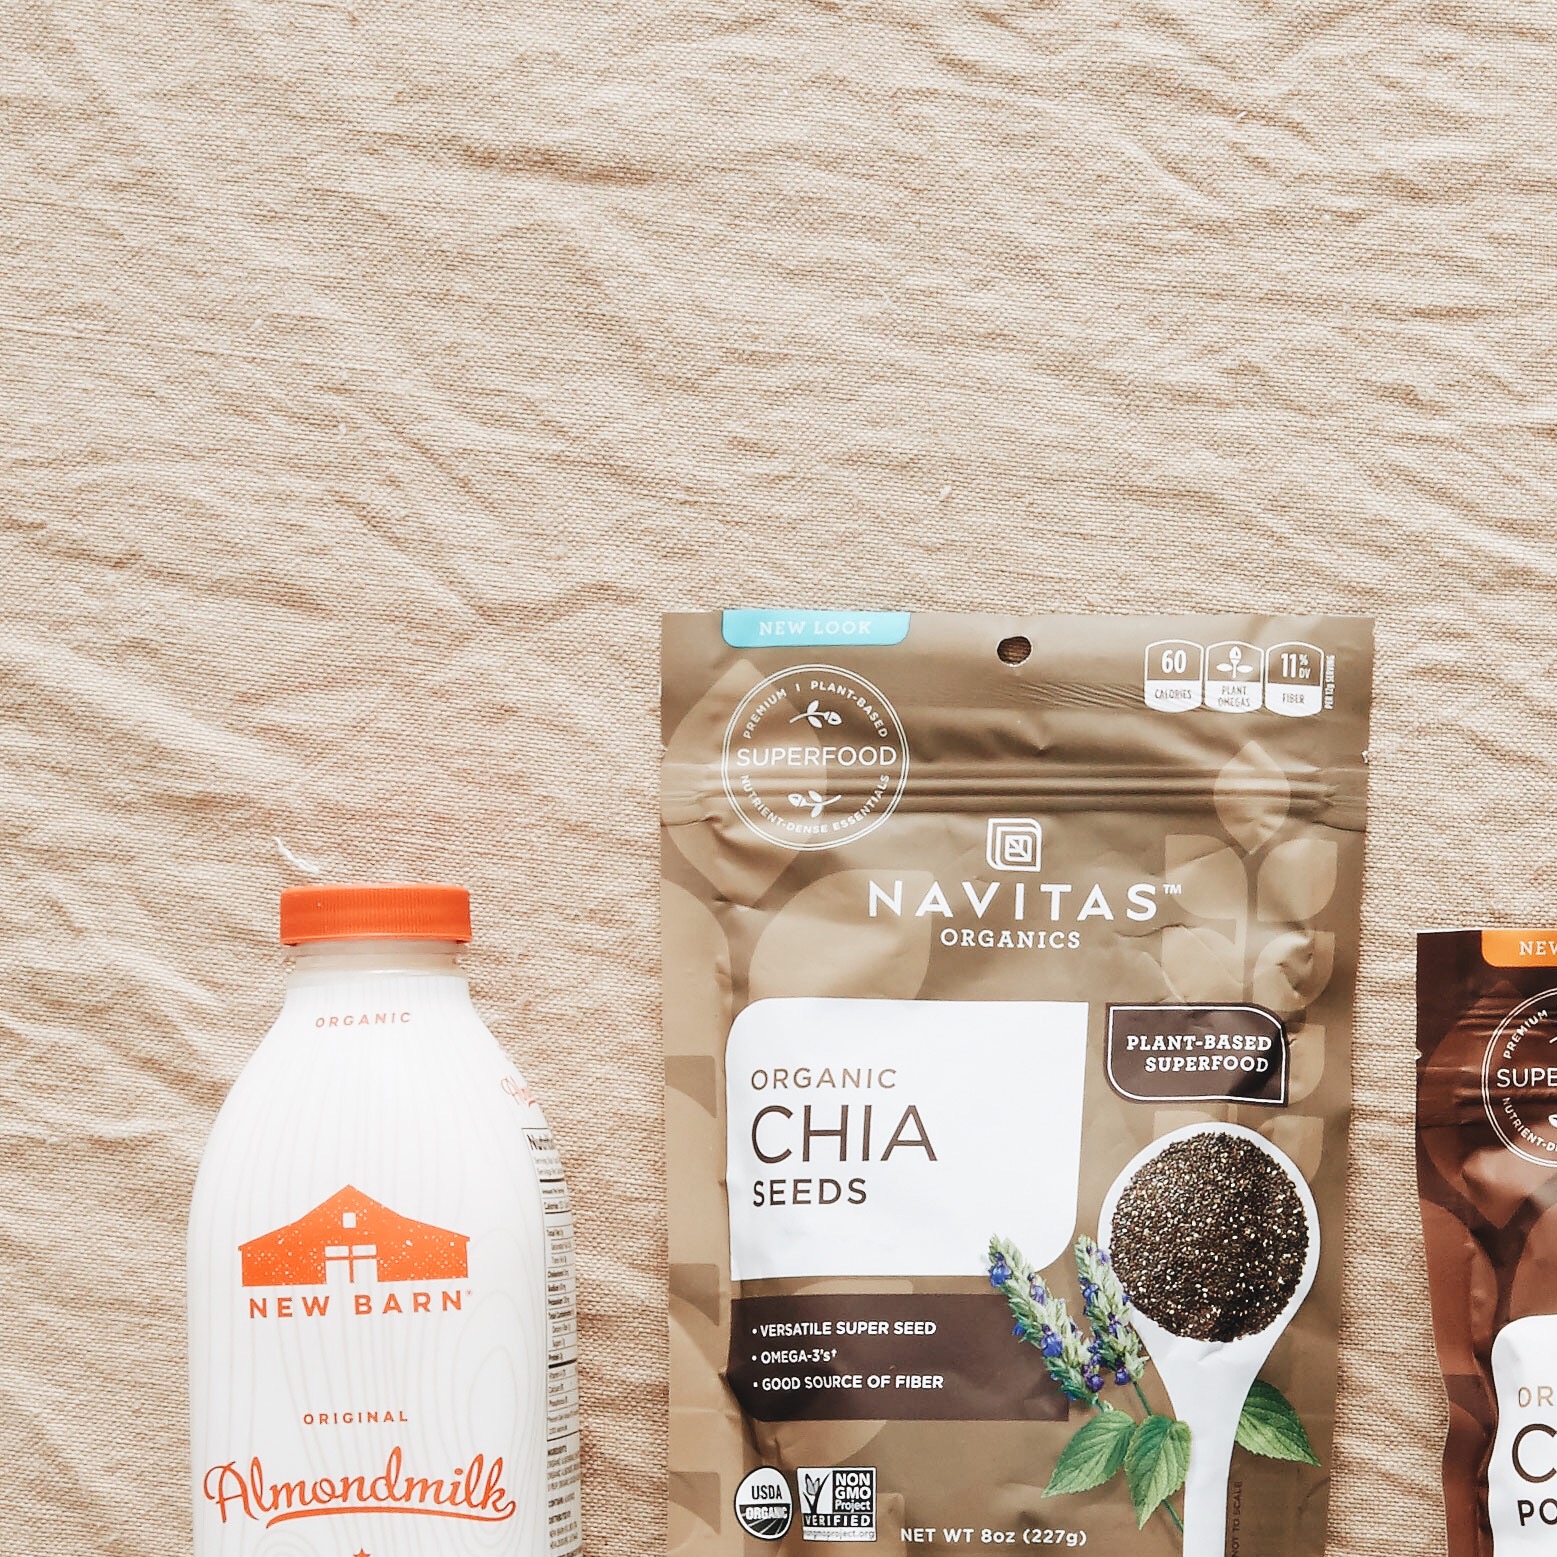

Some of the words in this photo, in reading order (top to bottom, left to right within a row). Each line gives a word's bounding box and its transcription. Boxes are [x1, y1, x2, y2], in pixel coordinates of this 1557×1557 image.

[759, 621, 806, 635] NEW
[814, 620, 872, 635] LOOK
[1161, 650, 1187, 674] 60
[1280, 653, 1297, 678] 11
[736, 746, 898, 767] SUPERFOOD
[941, 928, 1081, 949] ORGANICS
[315, 1012, 411, 1028] ORGANIC
[1503, 1009, 1549, 1059] PREMIUM
[1126, 1035, 1272, 1052] PLANT-BASED
[1144, 1055, 1268, 1073] SUPERFOOD
[751, 1068, 897, 1091] ORGANIC
[751, 1105, 938, 1164] CHIA
[752, 1178, 867, 1208] SEEDS
[249, 1296, 330, 1319] NEW
[354, 1289, 463, 1316] BARN
[760, 1322, 831, 1338] VERSATILE
[836, 1321, 889, 1336] SUPER
[893, 1321, 937, 1336] SEED
[762, 1376, 801, 1391] GOOD
[804, 1375, 863, 1390] SOURCE
[867, 1374, 891, 1389] OF
[895, 1374, 944, 1389] FIBER
[303, 1411, 409, 1425] ORIGINAL
[203, 1446, 517, 1527] Almondmilk
[835, 1472, 870, 1486] NON
[751, 1484, 783, 1500] USDA
[835, 1486, 872, 1500] GMO
[805, 1515, 871, 1527] VERIFIED
[900, 1528, 936, 1543] NET
[943, 1528, 974, 1543] WT
[981, 1528, 1016, 1543] 8oz
[1022, 1528, 1087, 1547] (227g)
